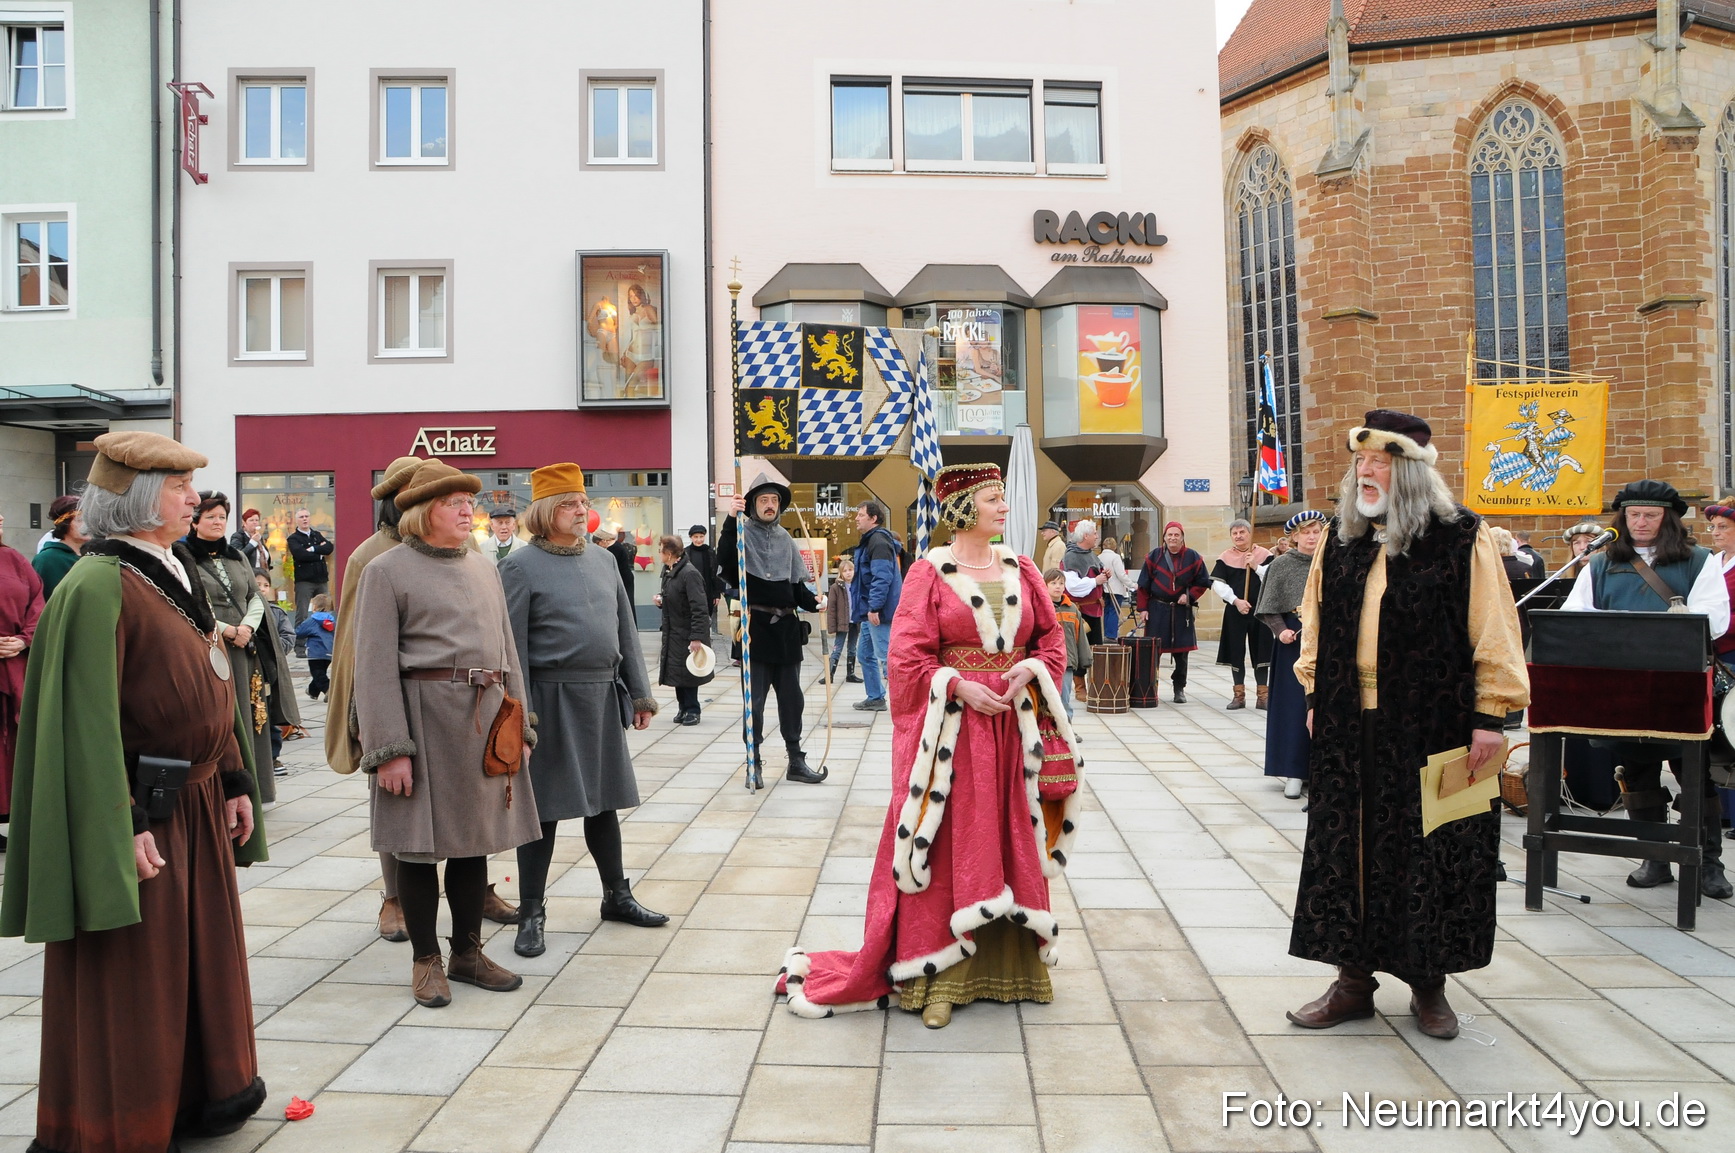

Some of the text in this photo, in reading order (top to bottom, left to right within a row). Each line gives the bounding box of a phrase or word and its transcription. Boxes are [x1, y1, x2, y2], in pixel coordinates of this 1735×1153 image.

[187, 102, 198, 168] Achatz
[1033, 209, 1168, 246] RACKL
[1050, 245, 1153, 264] am Rathaus
[947, 308, 992, 320] 100 Jahre
[943, 321, 985, 341] RACKL
[1496, 388, 1579, 400] Festspielverein
[959, 408, 985, 423] 100
[408, 426, 496, 456] Achatz
[272, 494, 304, 505] Achatz
[611, 498, 642, 508] Achatz
[1477, 494, 1588, 506] Neunburg v.W. e.V.
[815, 502, 844, 515] RACKL
[1093, 502, 1120, 516] RACKL
